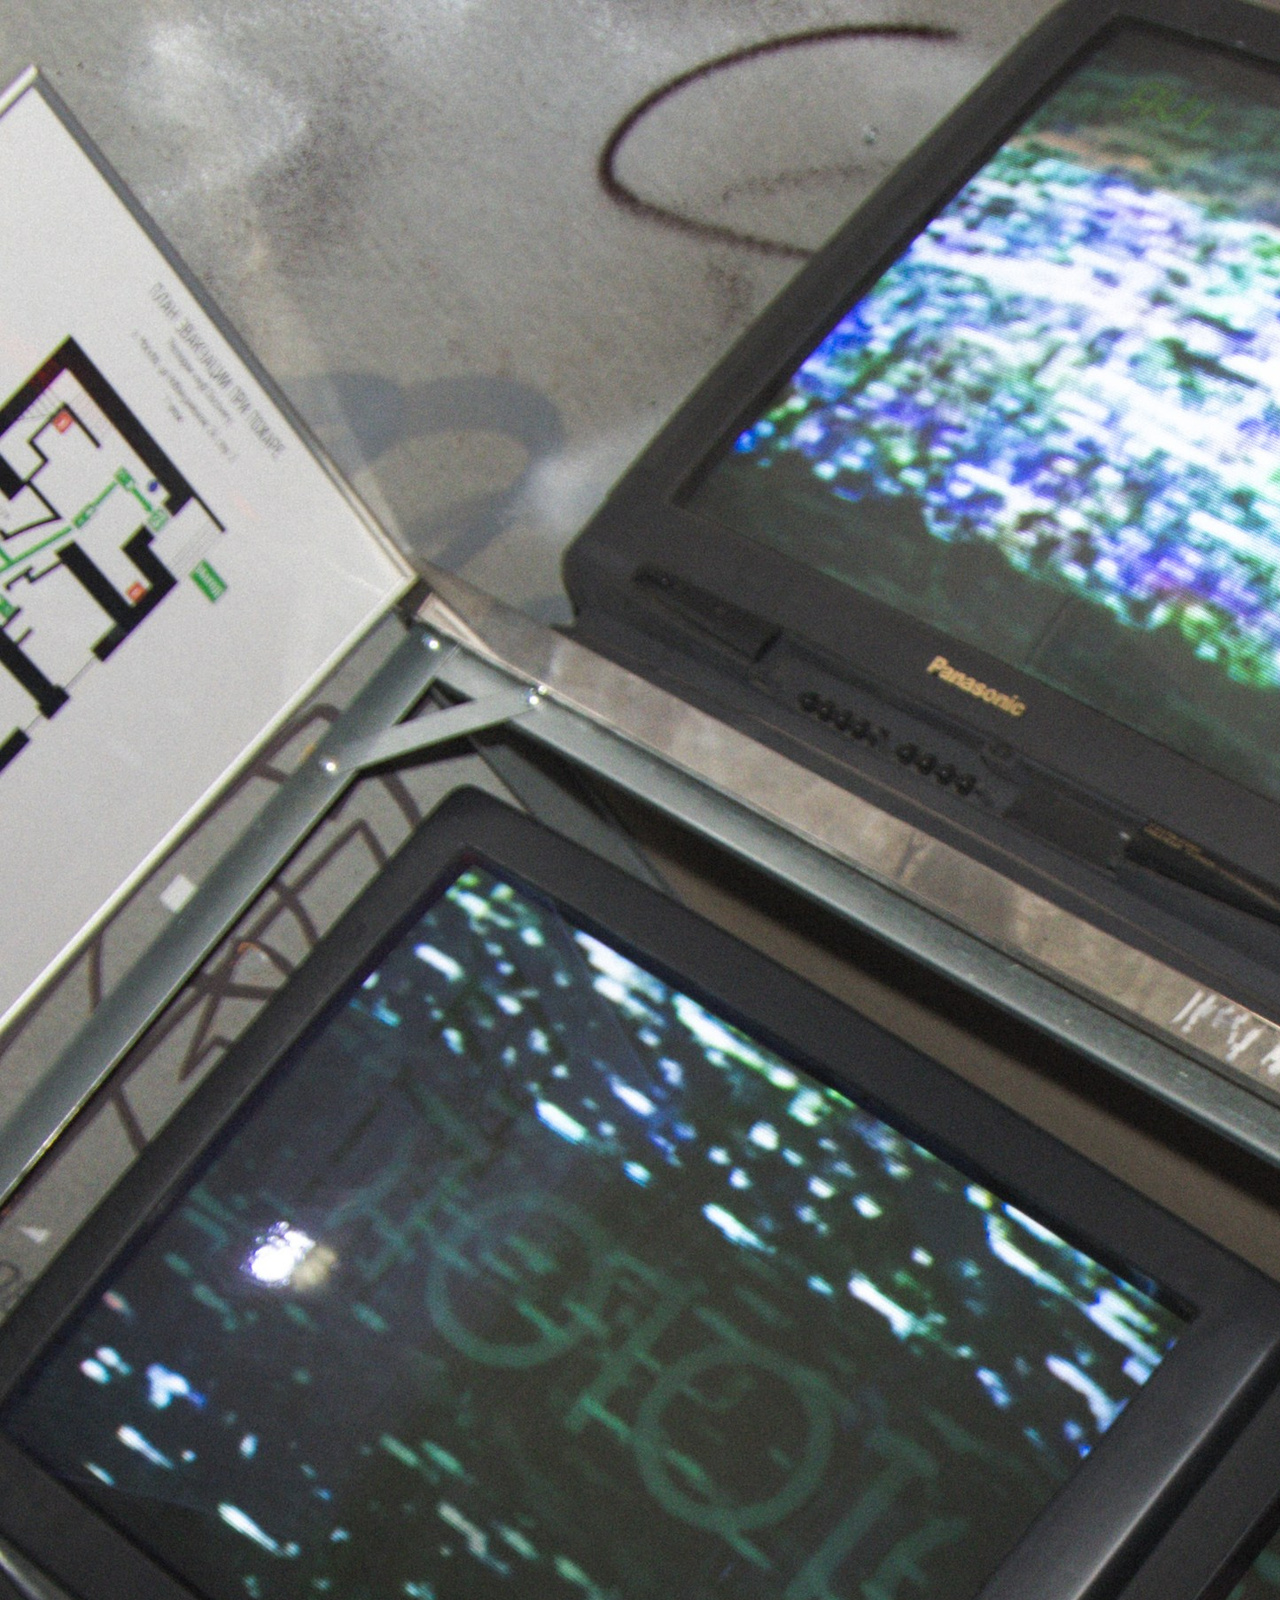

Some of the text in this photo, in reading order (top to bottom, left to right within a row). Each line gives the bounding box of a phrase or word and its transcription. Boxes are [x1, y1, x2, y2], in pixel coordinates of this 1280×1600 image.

[150, 282, 180, 321] ПЛАН
[229, 384, 251, 415] ПРИ
[926, 655, 1026, 717] Panasonic
